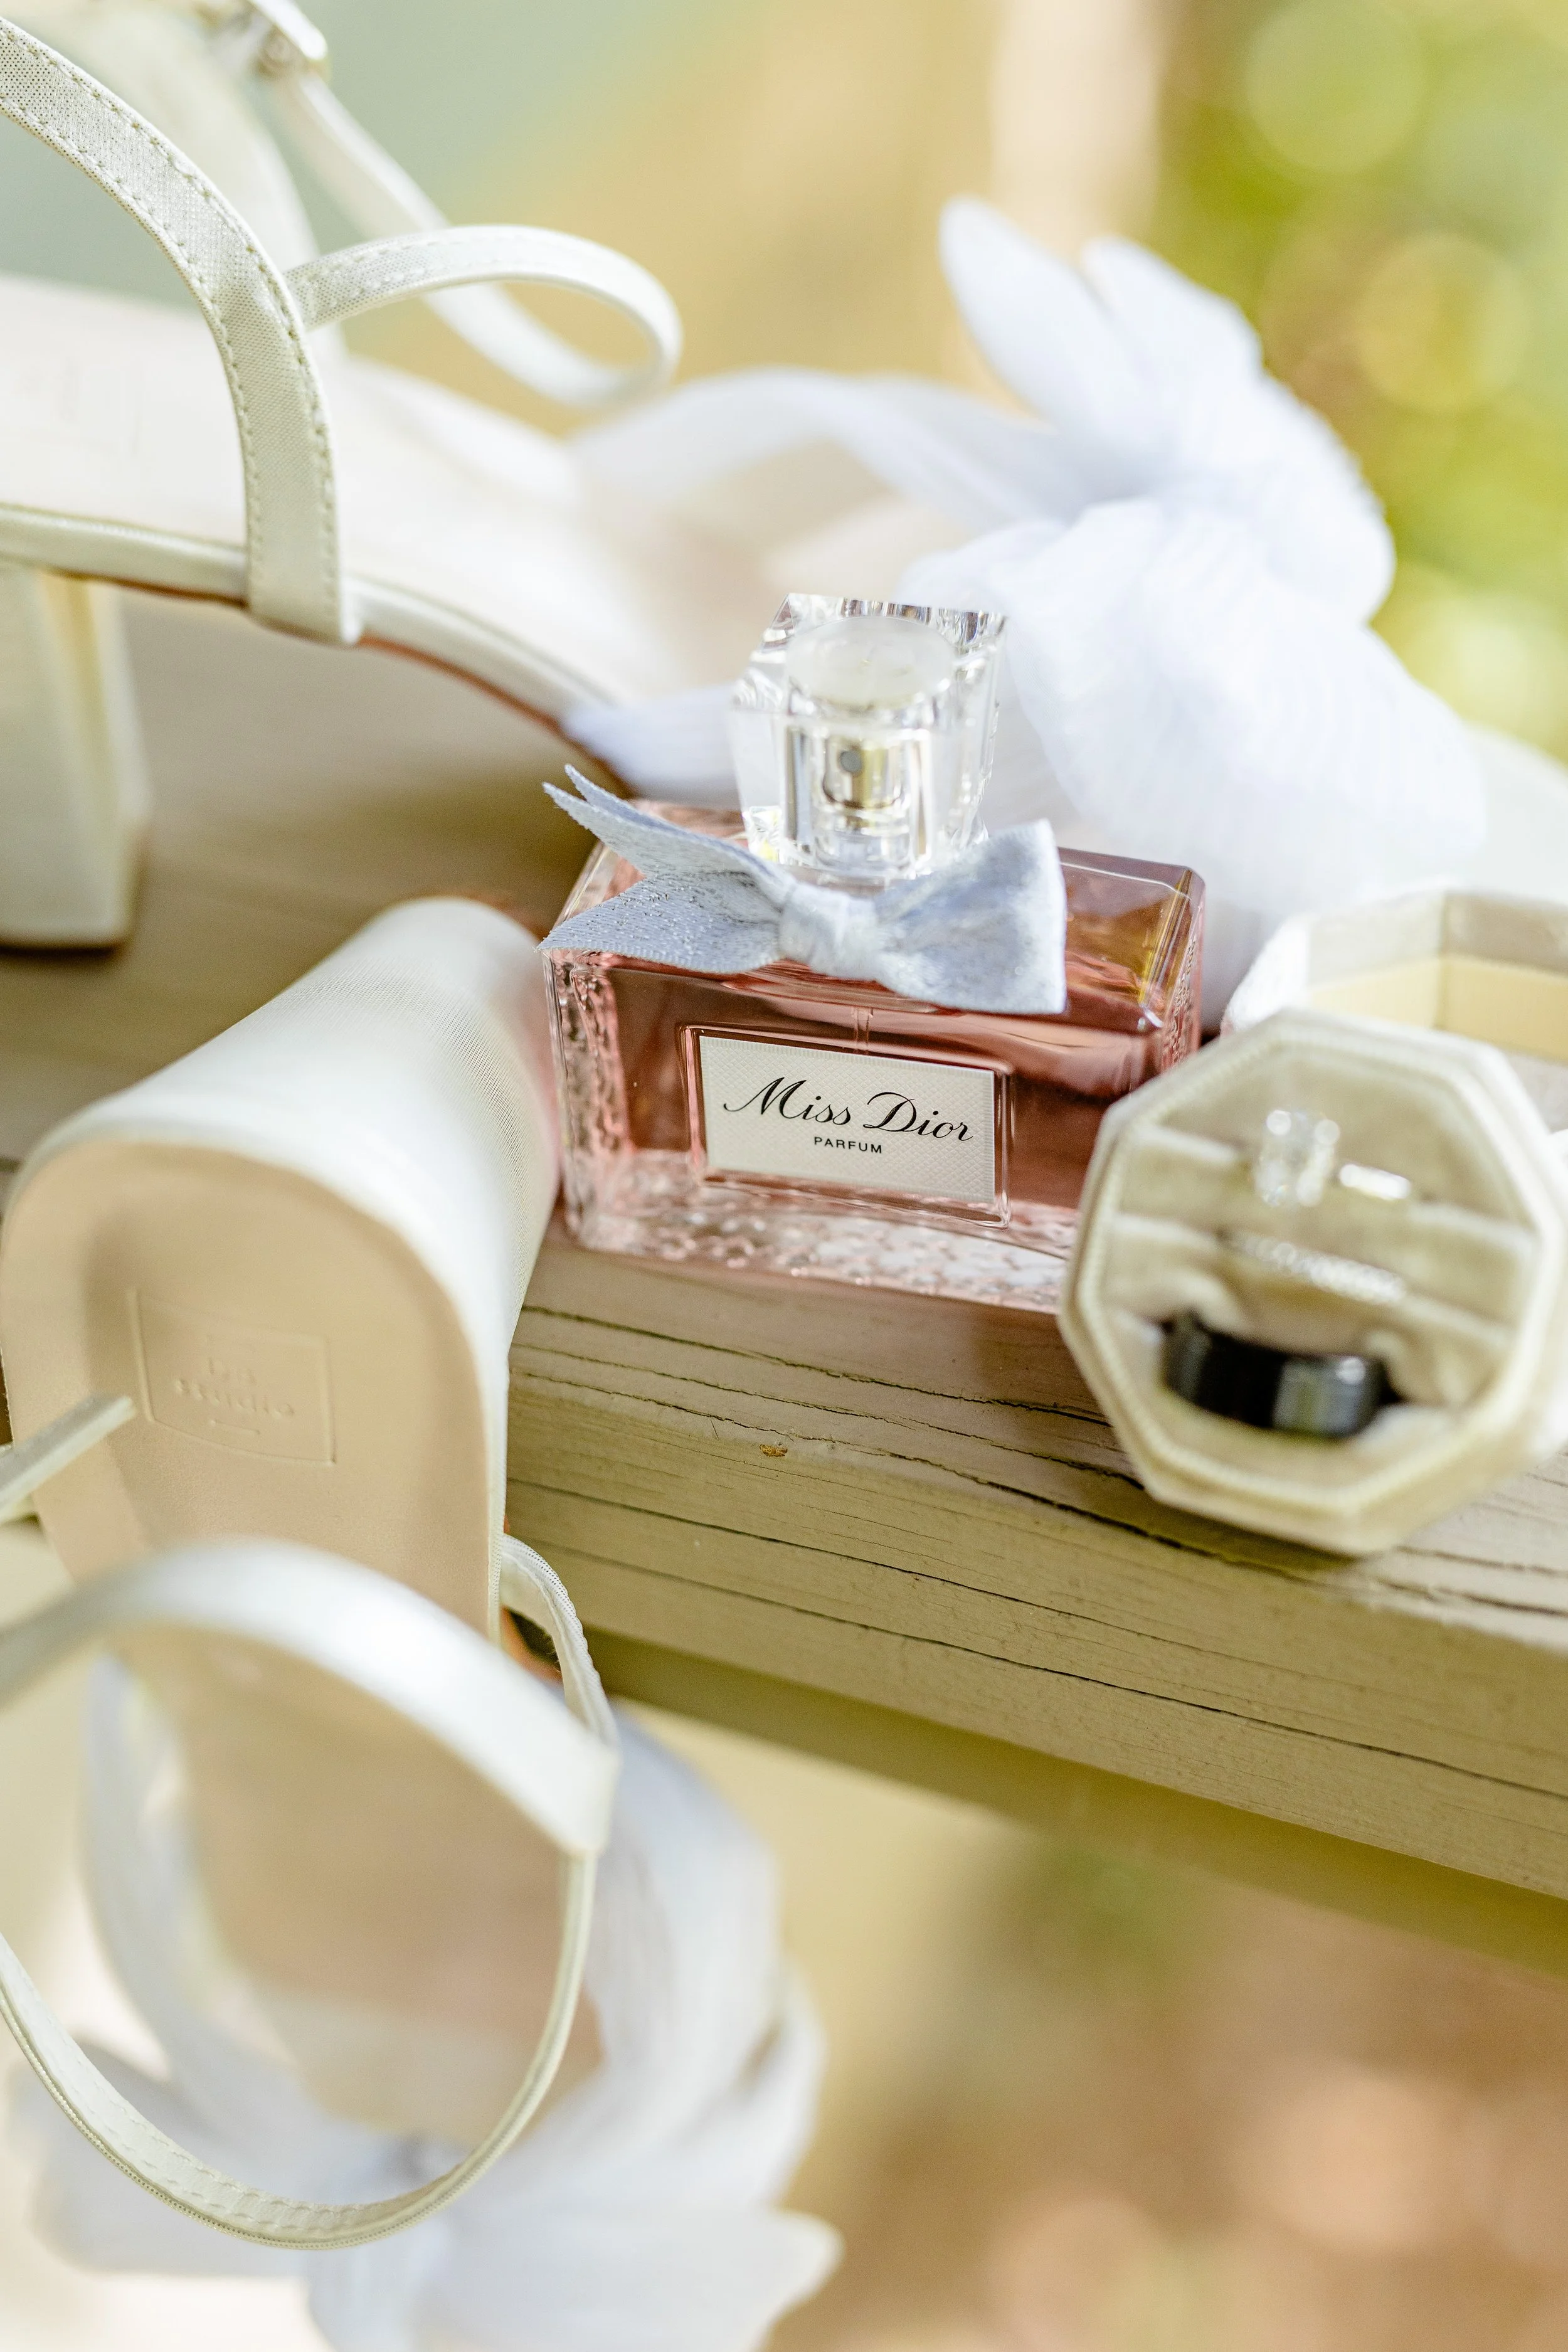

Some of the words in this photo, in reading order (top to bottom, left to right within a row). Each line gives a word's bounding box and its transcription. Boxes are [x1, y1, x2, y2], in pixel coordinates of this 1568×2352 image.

[723, 1076, 851, 1126] Miss
[862, 1091, 973, 1142] Dior
[813, 1136, 882, 1154] PARFUM
